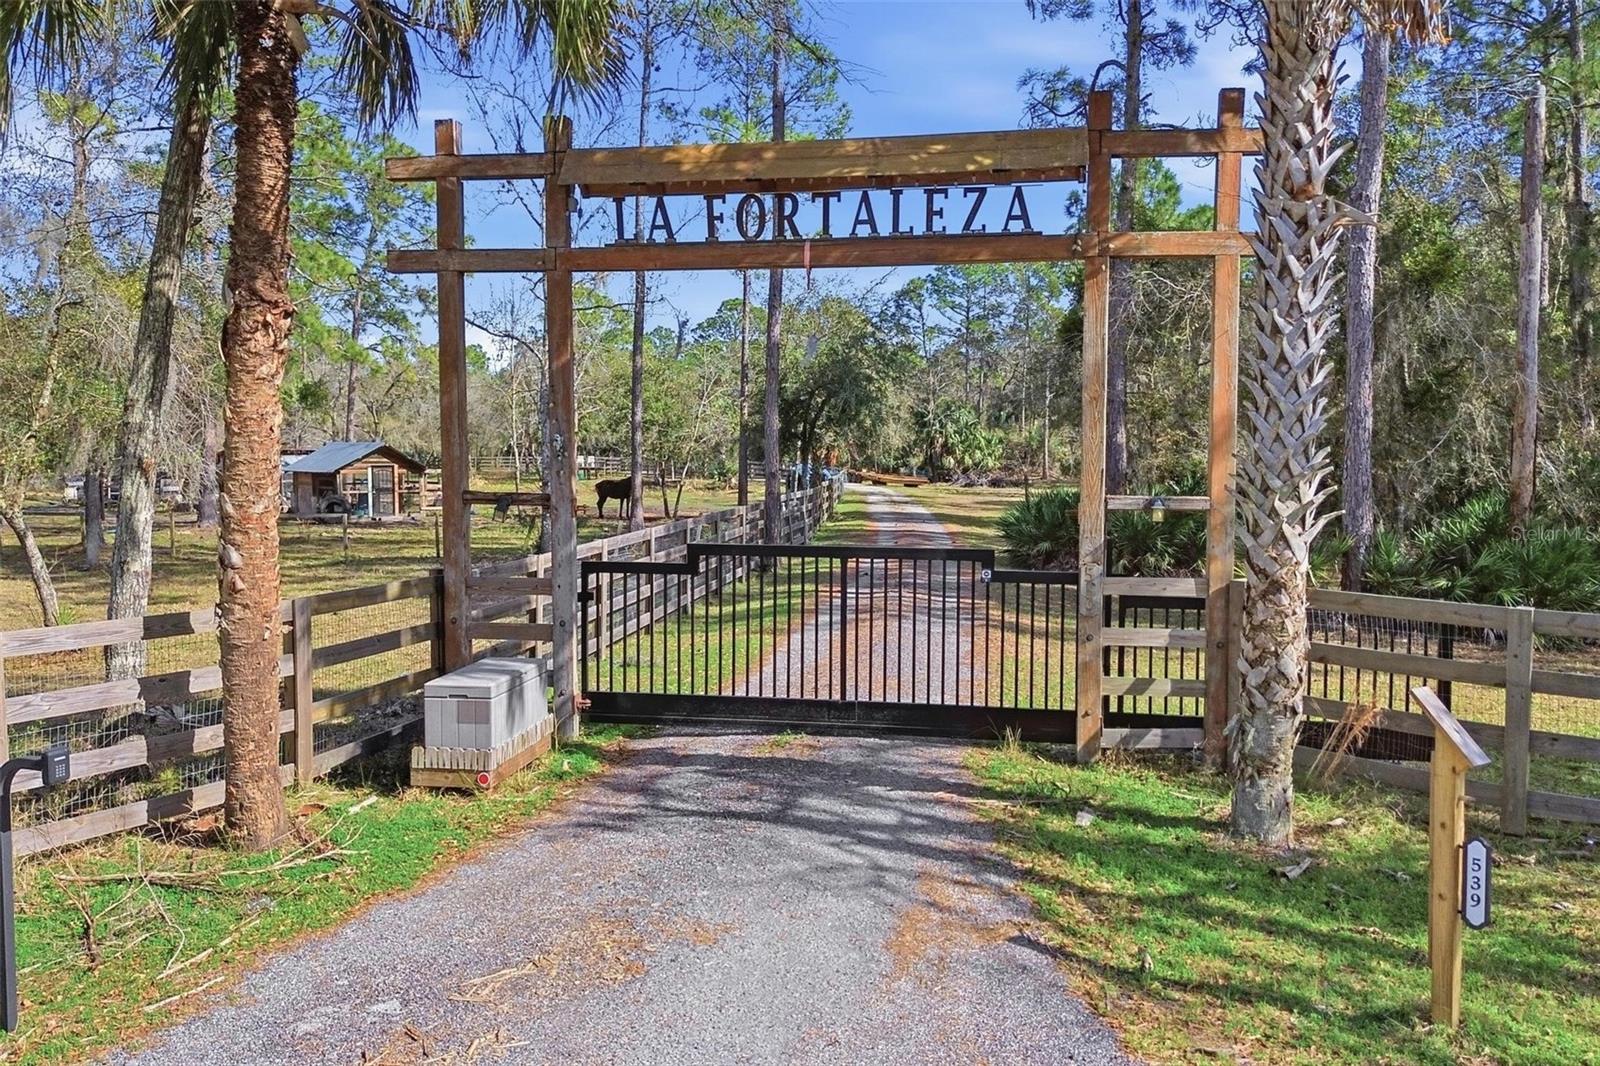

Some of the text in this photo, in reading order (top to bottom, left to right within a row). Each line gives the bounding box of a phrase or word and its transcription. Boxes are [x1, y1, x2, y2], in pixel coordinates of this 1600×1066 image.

[612, 185, 1035, 244] LA FORTALEZA
[1470, 857, 1482, 908] 539
